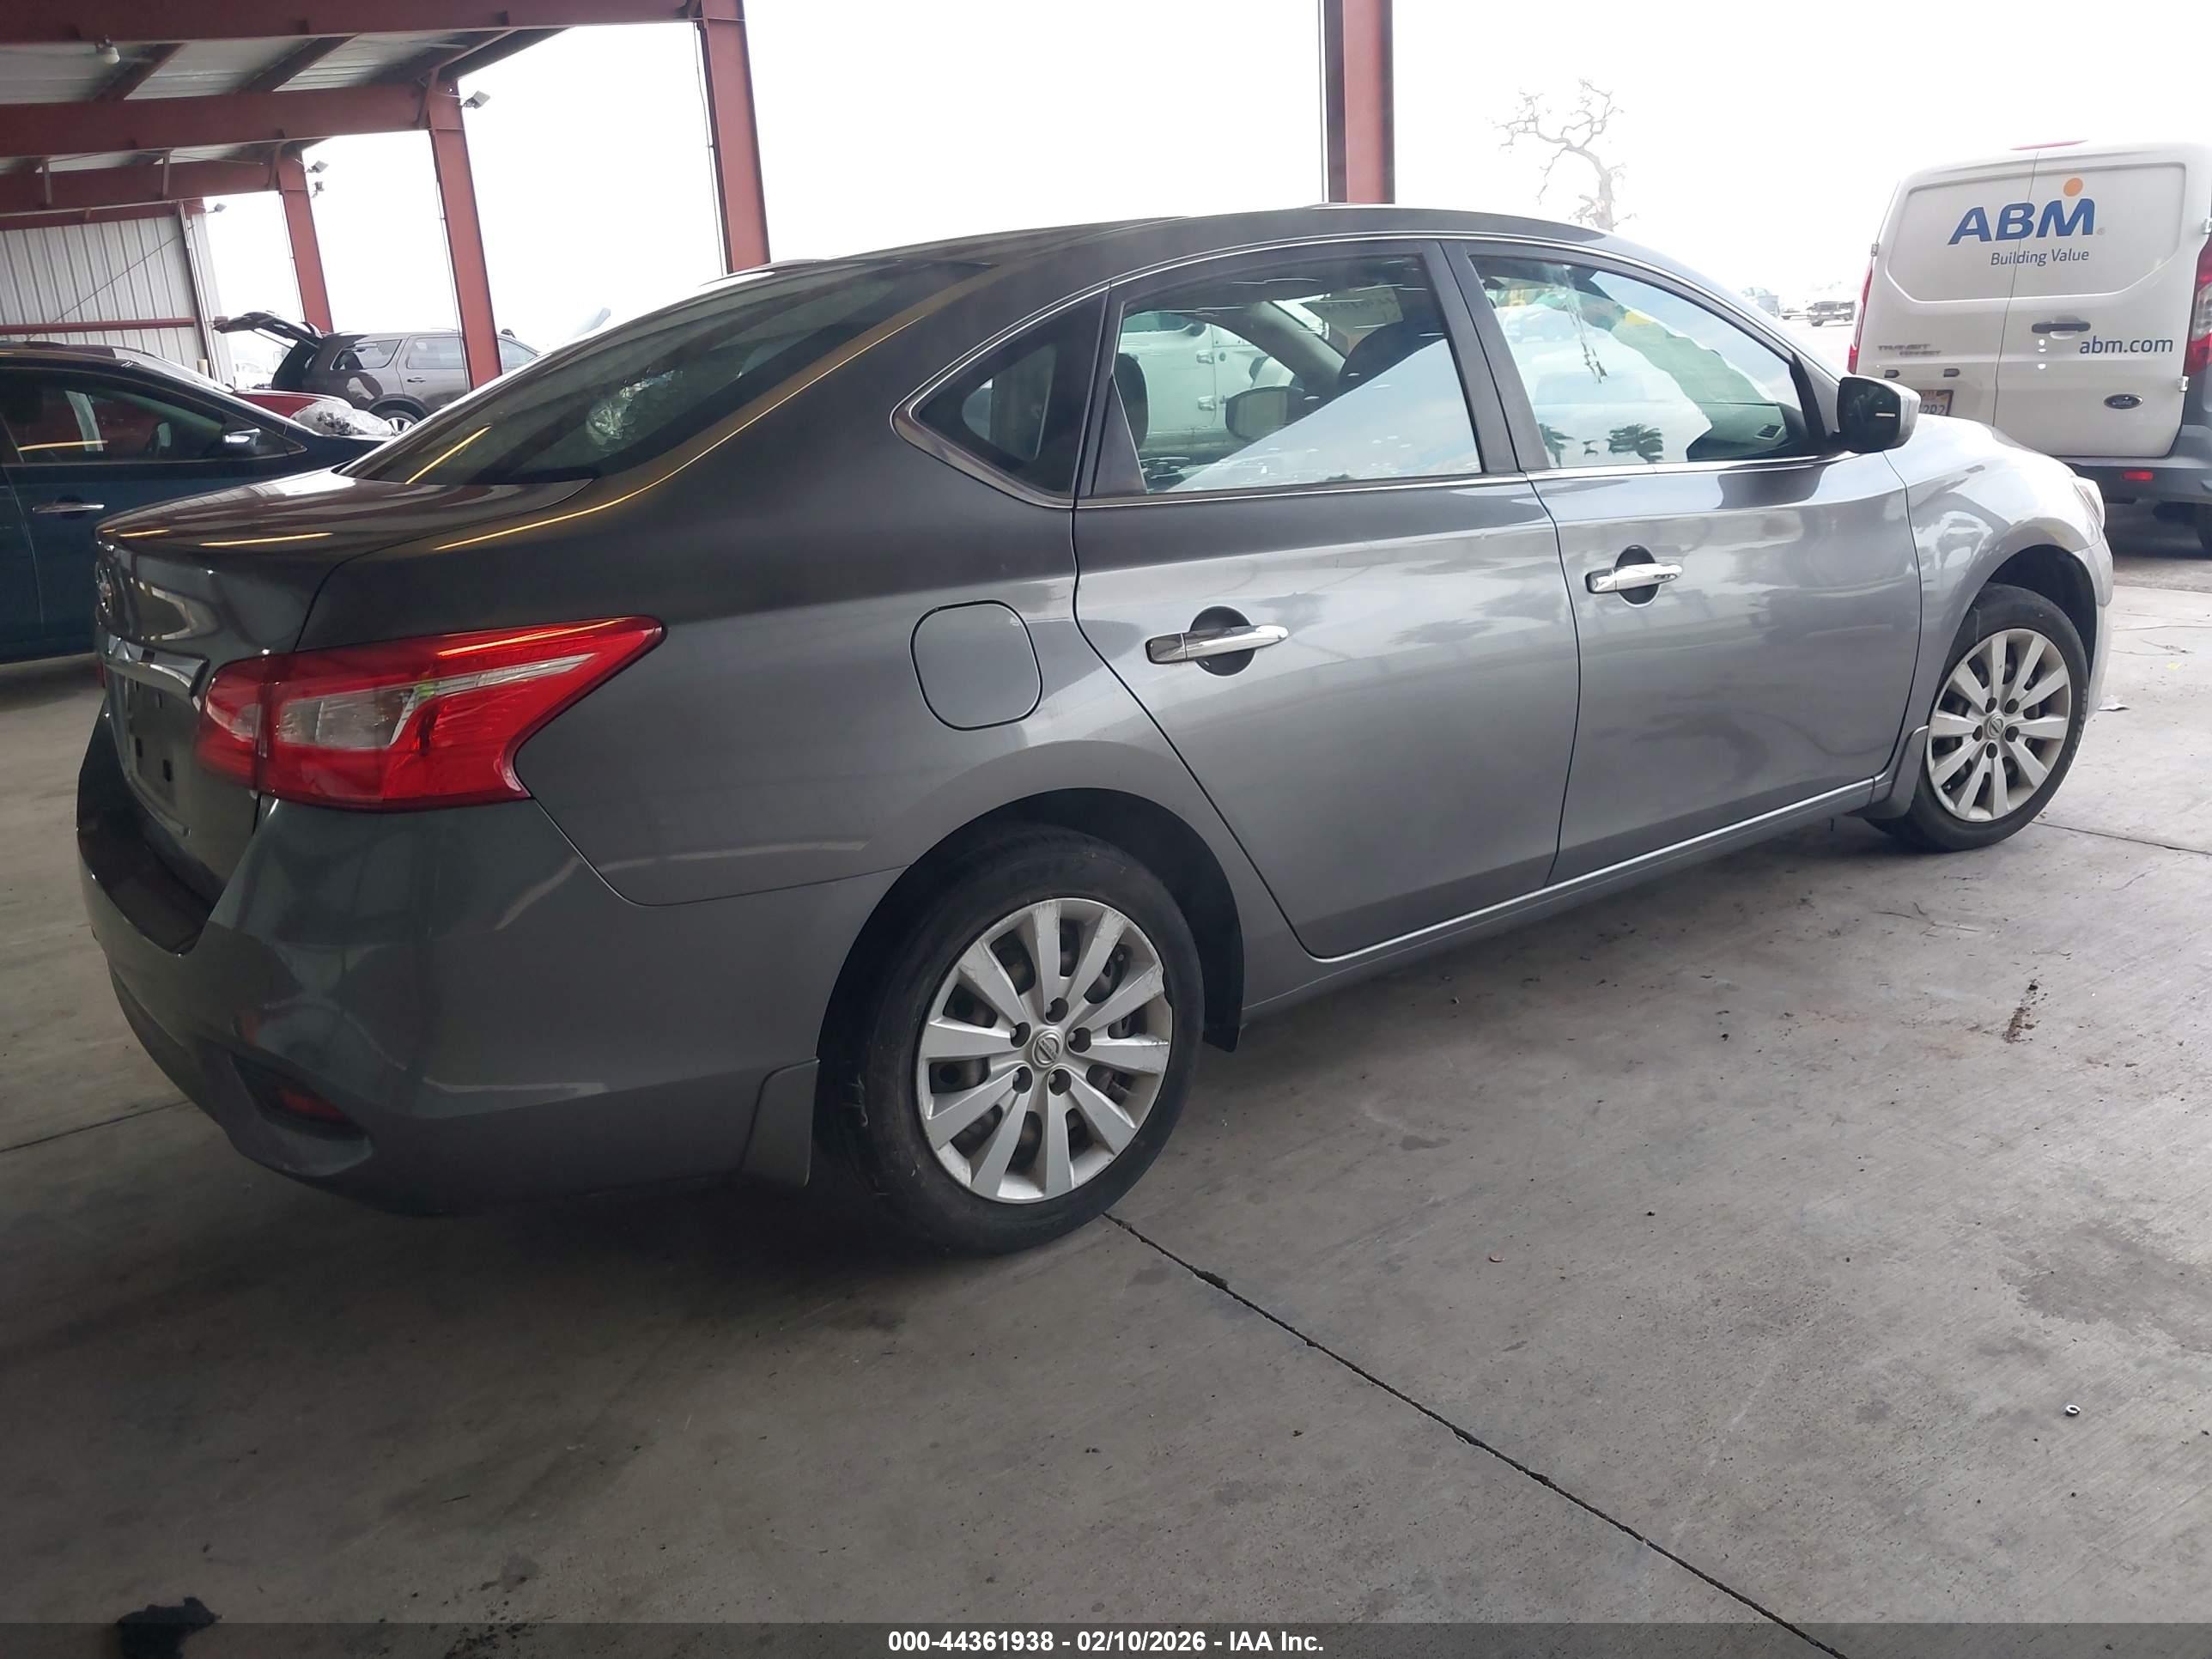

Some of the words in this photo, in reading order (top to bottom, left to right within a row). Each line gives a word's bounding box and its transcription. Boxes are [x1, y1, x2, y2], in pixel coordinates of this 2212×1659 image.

[1947, 198, 2095, 246] ABM
[1990, 250, 2048, 267] Building
[2051, 247, 2089, 262] Value
[2079, 335, 2174, 354] abm.com
